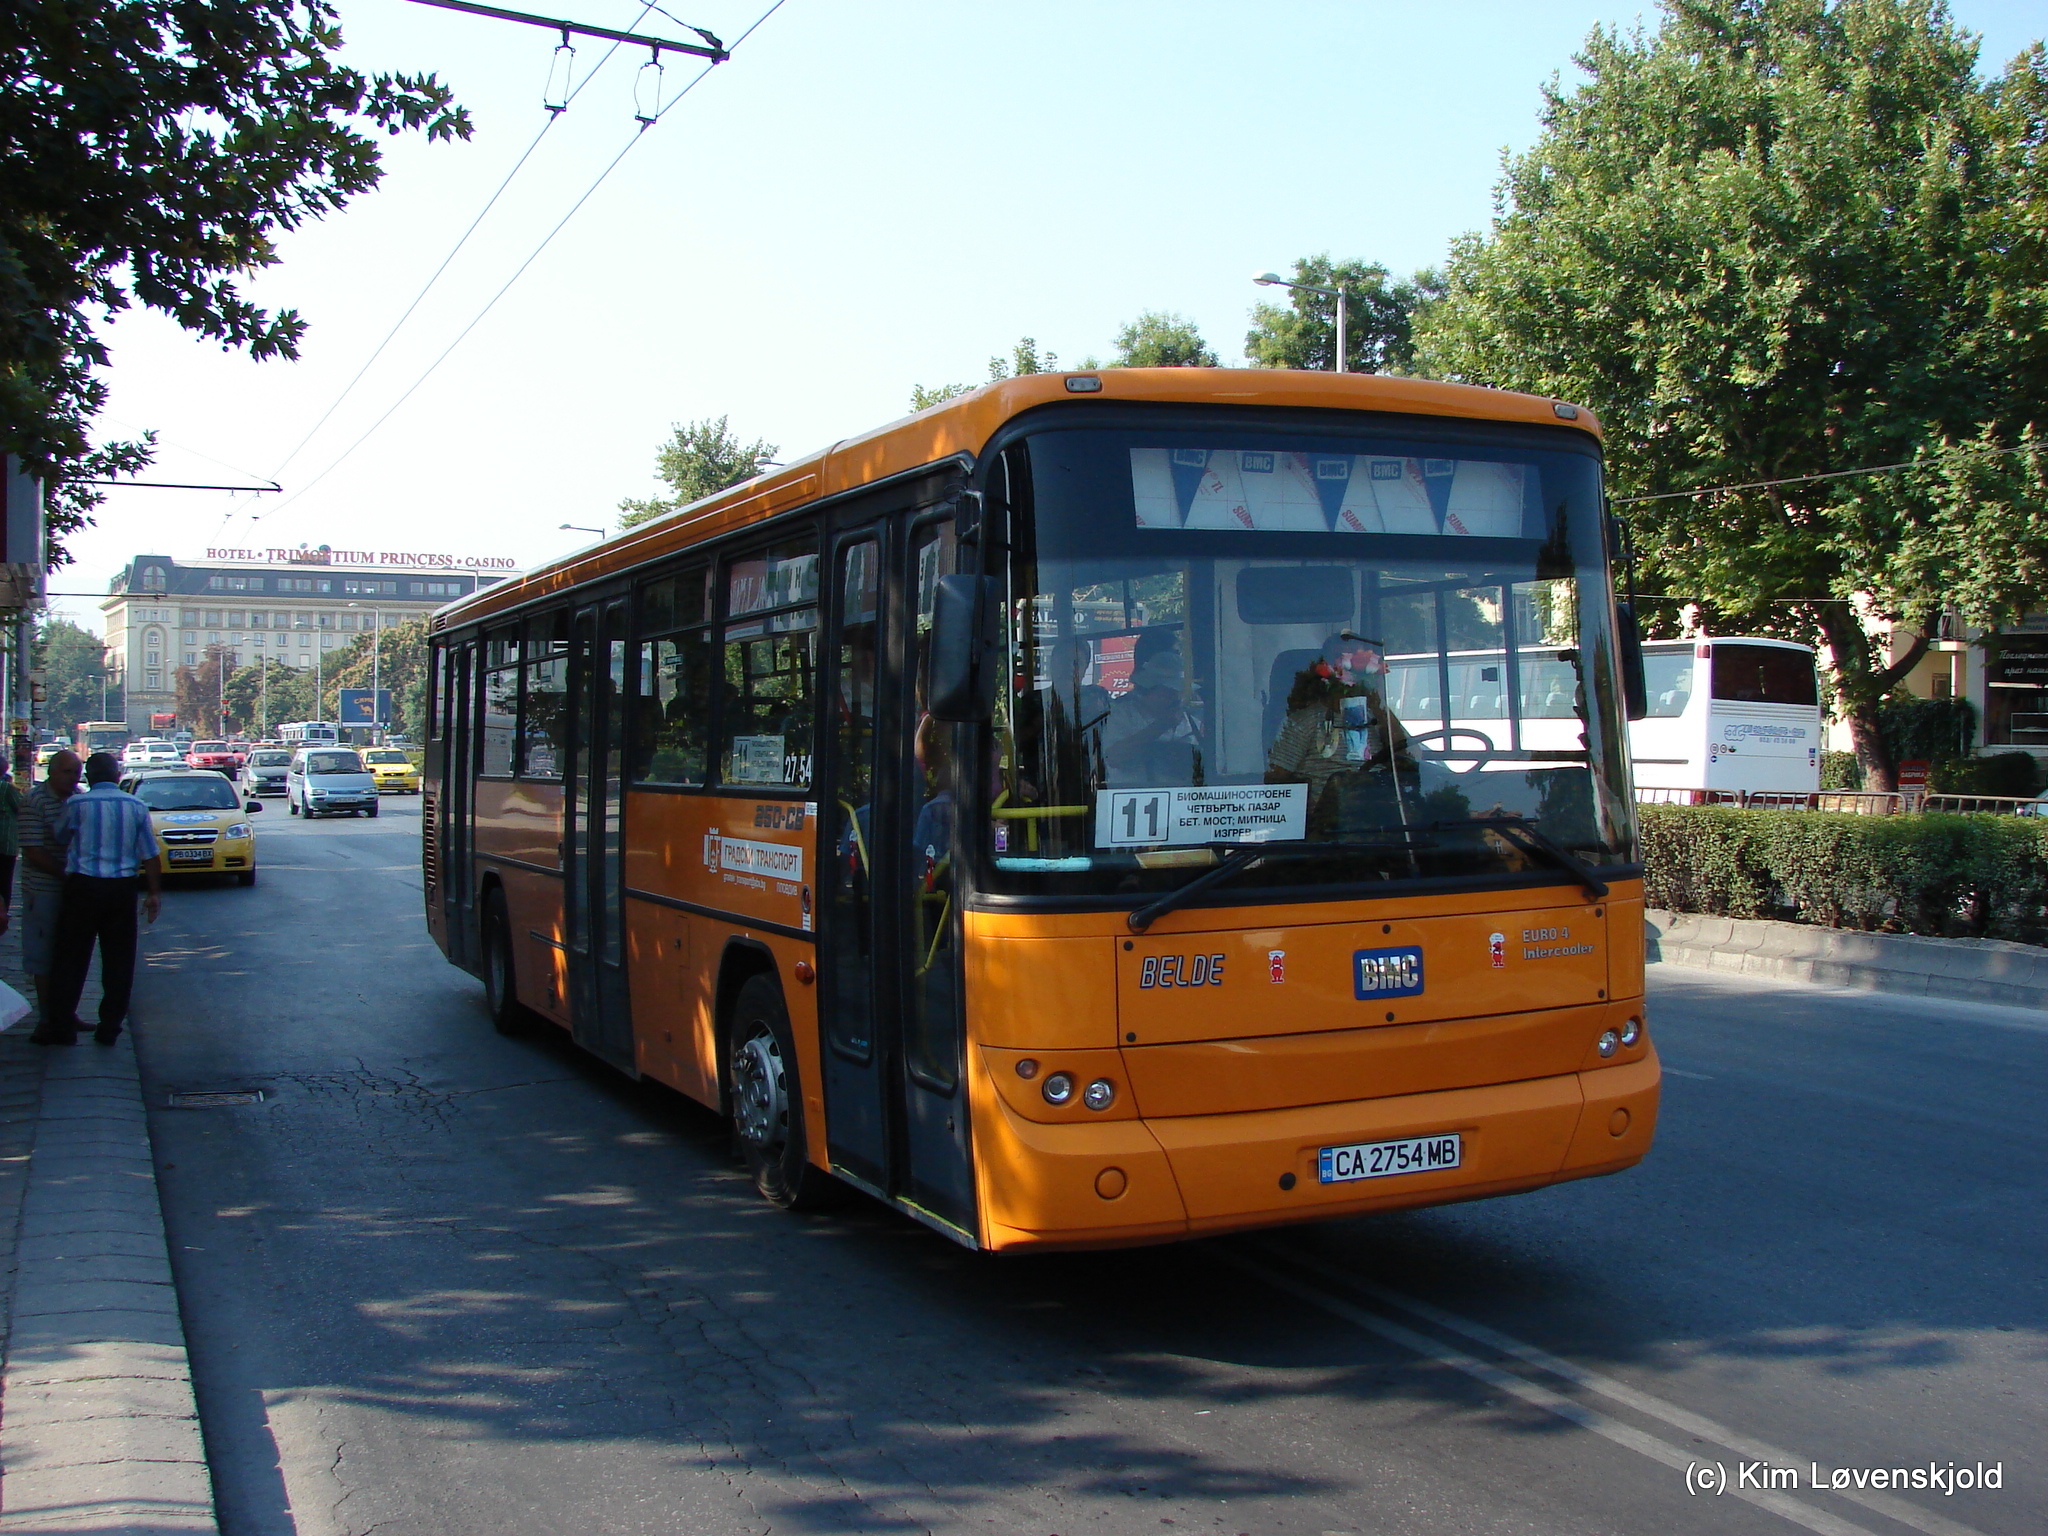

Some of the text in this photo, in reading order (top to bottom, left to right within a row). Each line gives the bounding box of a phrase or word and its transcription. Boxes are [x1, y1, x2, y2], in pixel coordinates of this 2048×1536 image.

[1244, 456, 1271, 471] BMC
[1373, 464, 1399, 478] BMC
[207, 548, 255, 560] HOTEL
[380, 552, 453, 566] PRINCESS
[465, 556, 515, 568] CASINO
[1177, 789, 1292, 801] БИОМАШИНОСТРОЕНЕ
[1187, 802, 1281, 813] ЧЕТВЪРТЪК ПАЗАР
[1122, 797, 1159, 838] 11
[1179, 814, 1287, 827] БЕТ. МОСТ; МИТНИЦА
[1214, 829, 1251, 838] ИЗГРЕВ
[725, 844, 798, 873] ГРАДСКИ ТРАНСПОРТ
[1523, 926, 1569, 942] EURO 4
[1523, 943, 1594, 960] Intercooler
[1140, 953, 1226, 989] BELDE
[1360, 953, 1419, 992] BMC
[1336, 1139, 1456, 1176] CA 2754 MB
[1322, 1169, 1332, 1178] BG
